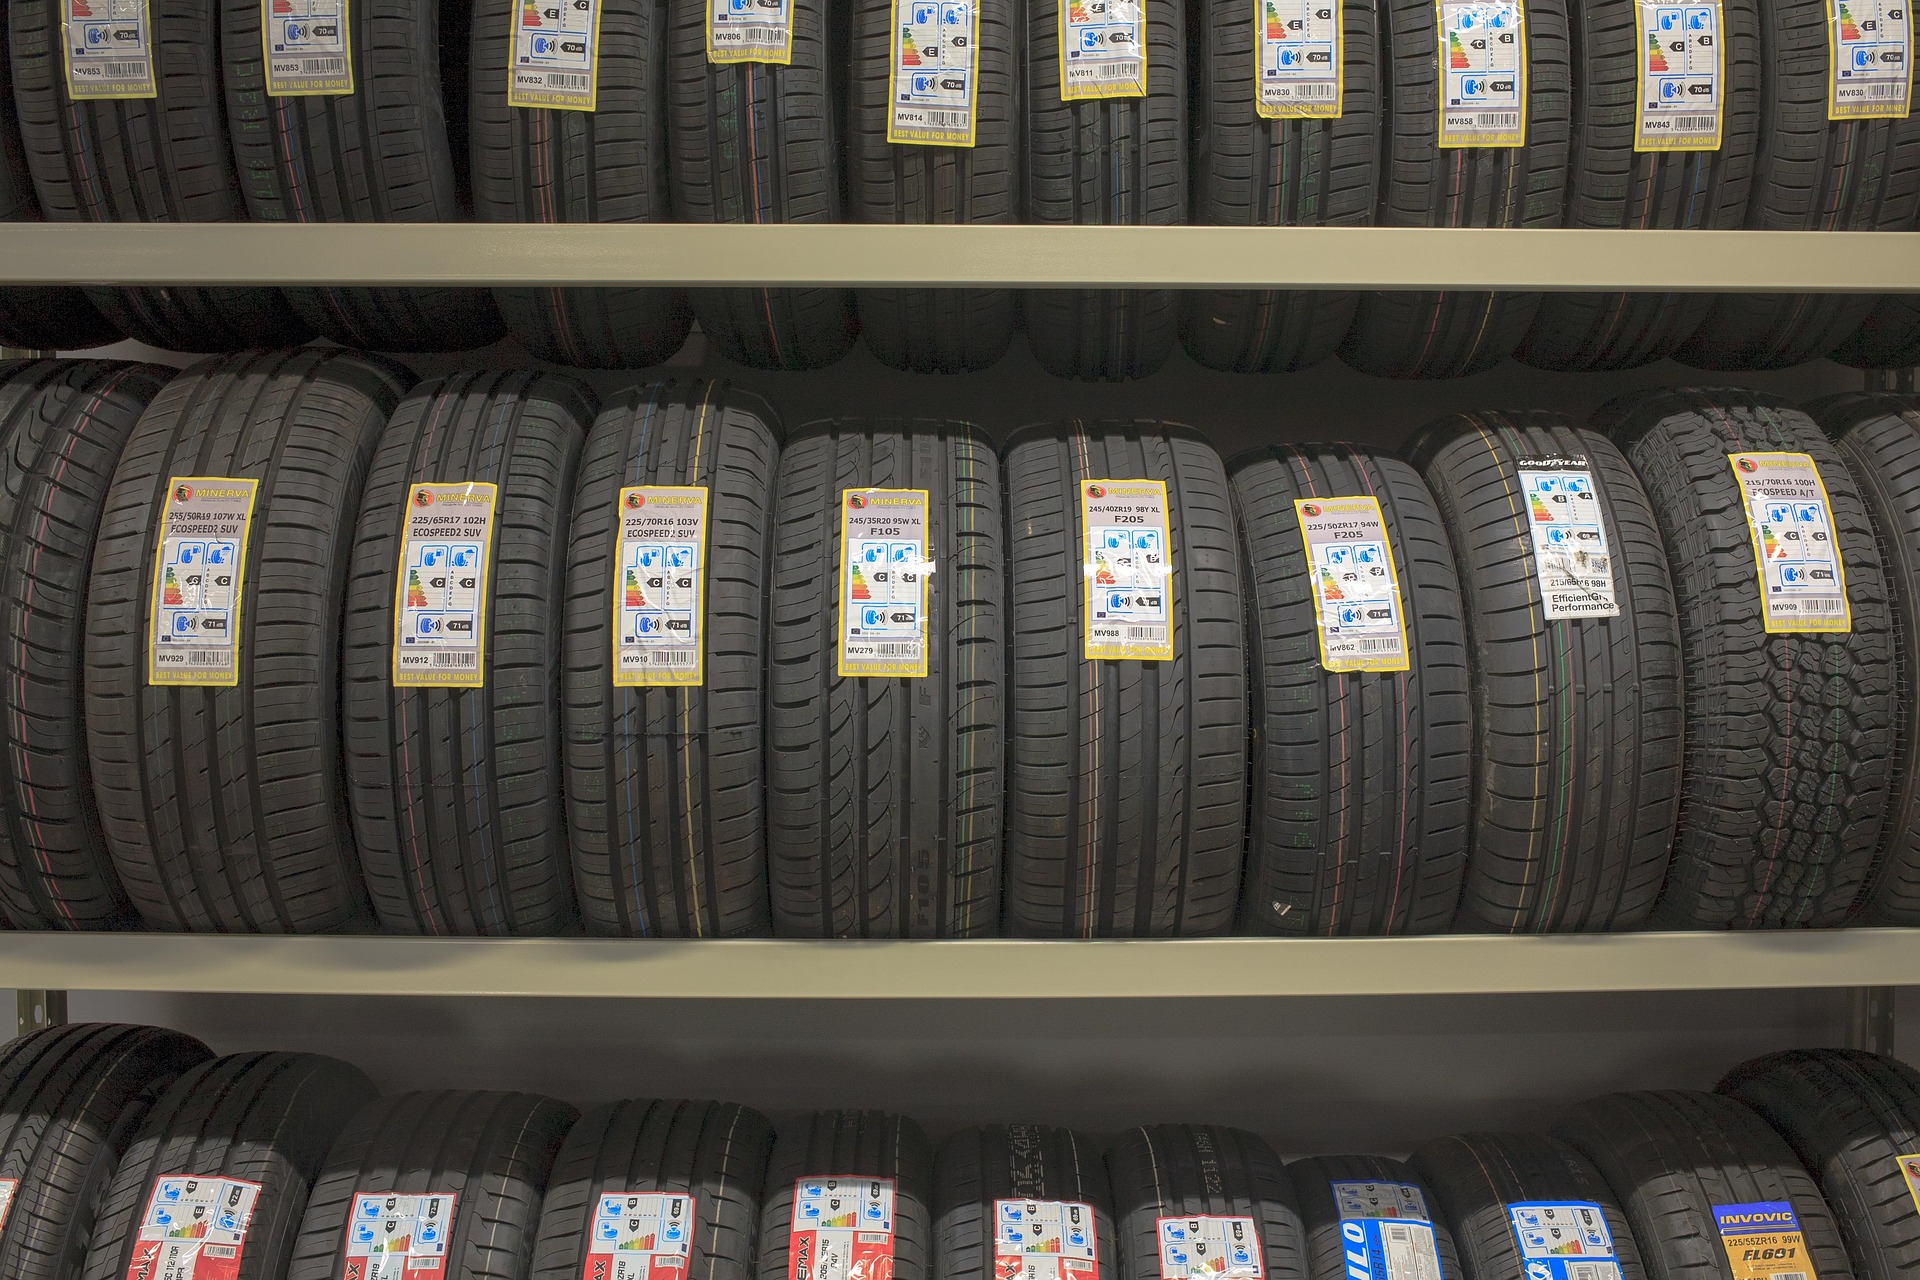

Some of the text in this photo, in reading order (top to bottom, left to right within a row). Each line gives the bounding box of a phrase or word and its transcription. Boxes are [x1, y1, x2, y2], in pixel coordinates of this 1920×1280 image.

[764, 49, 786, 57] MONEY
[310, 80, 322, 88] FOR
[325, 80, 348, 88] MONEY
[517, 76, 542, 84] MV832
[112, 84, 126, 92] FOR
[1839, 89, 1864, 97] MV830
[552, 94, 564, 102] FOR
[567, 96, 590, 104] MONEY
[894, 130, 969, 141] BEST VALUE FOR MONEY
[1444, 134, 1459, 142] BEST
[196, 488, 249, 498] MINERVA
[1800, 489, 1815, 497] A/T
[436, 494, 491, 503] MINERVA
[648, 496, 702, 504] MINERVA
[870, 498, 922, 506] MINERVA
[169, 512, 246, 521] 255/50R19 107W XL
[412, 517, 486, 525] 225/65R17 102H
[626, 518, 674, 526] 225/70R16
[171, 524, 238, 533] ECOSPEED2 SUV
[1308, 522, 1358, 531] 225/50ZR17
[413, 528, 482, 537] ECOSPEED2 SUV
[678, 530, 695, 538] SUV
[1334, 531, 1364, 539] F205
[1552, 602, 1614, 612] Performance
[1720, 1212, 1793, 1224] INVOVIC
[1728, 1235, 1800, 1247] 225/55ZR16 99W
